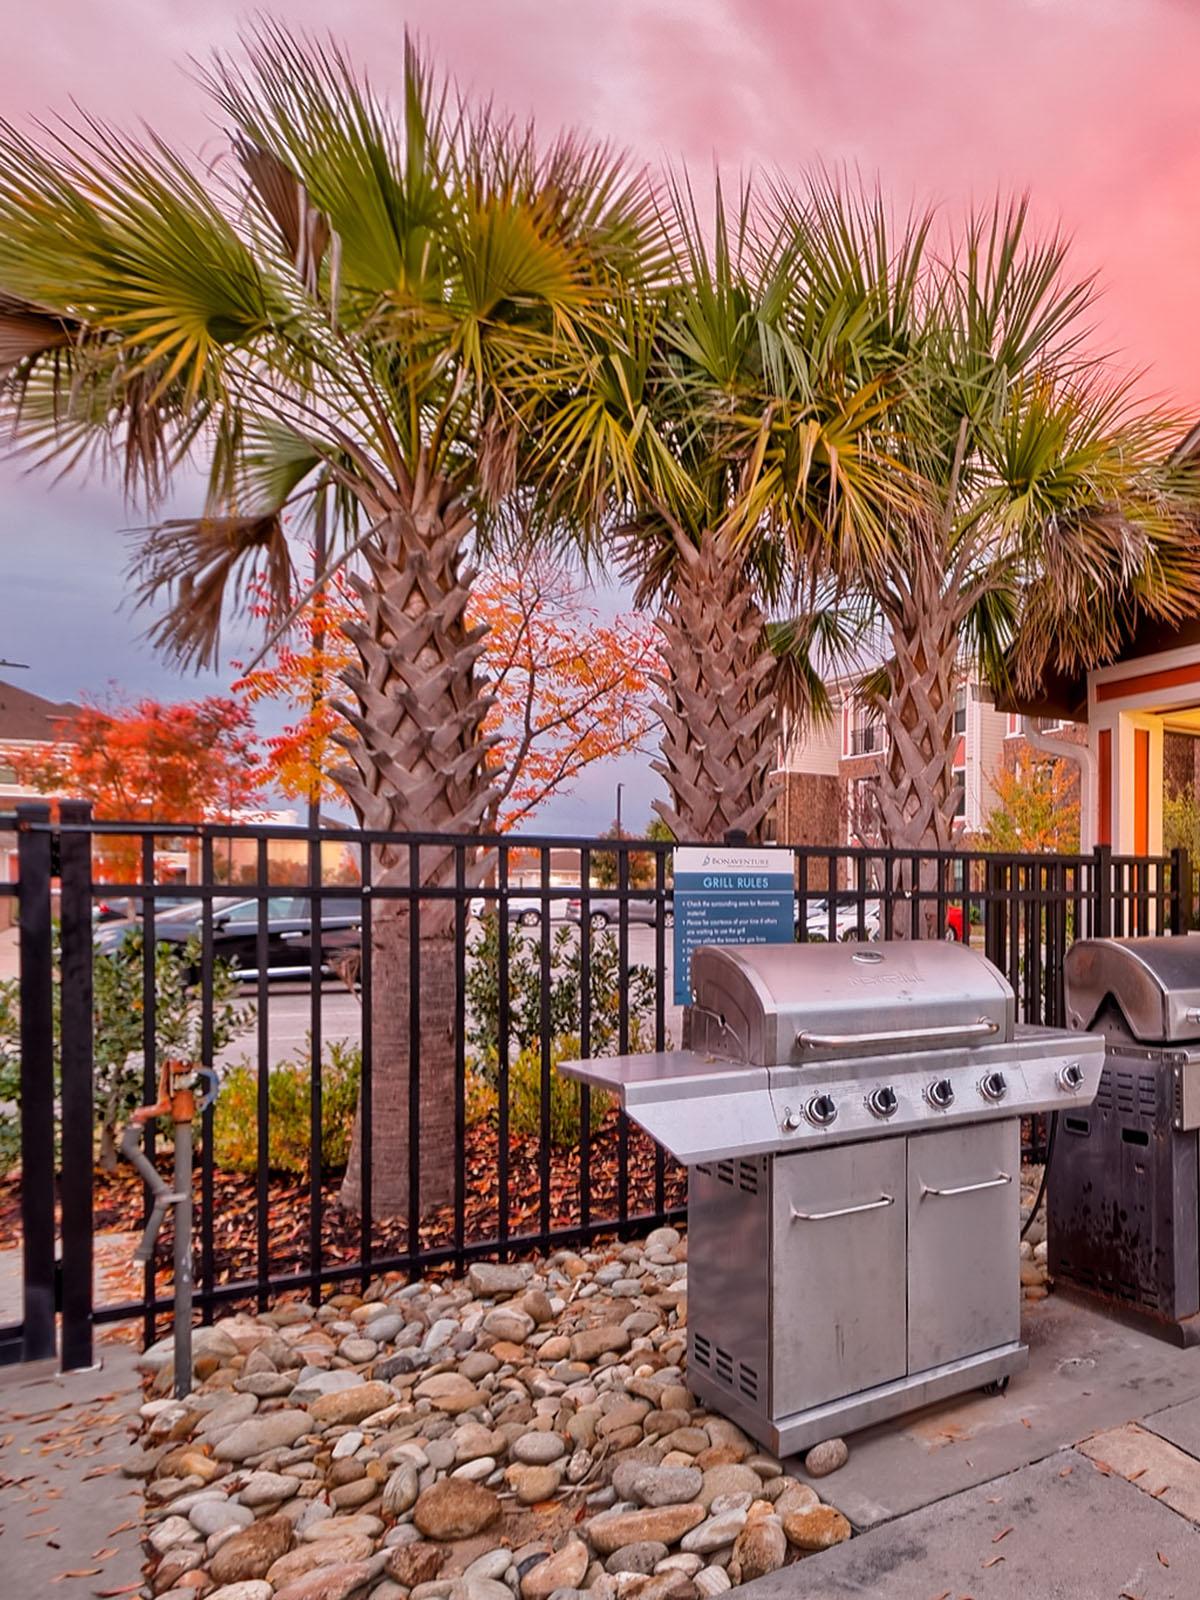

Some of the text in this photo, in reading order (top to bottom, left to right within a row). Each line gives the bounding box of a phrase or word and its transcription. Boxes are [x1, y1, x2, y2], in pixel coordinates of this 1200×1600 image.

[712, 857, 769, 865] BONAVENTURE
[703, 877, 769, 888] GRILL RULES
[687, 900, 701, 908] Check
[711, 900, 737, 908] surrounding
[696, 928, 713, 936] waiting
